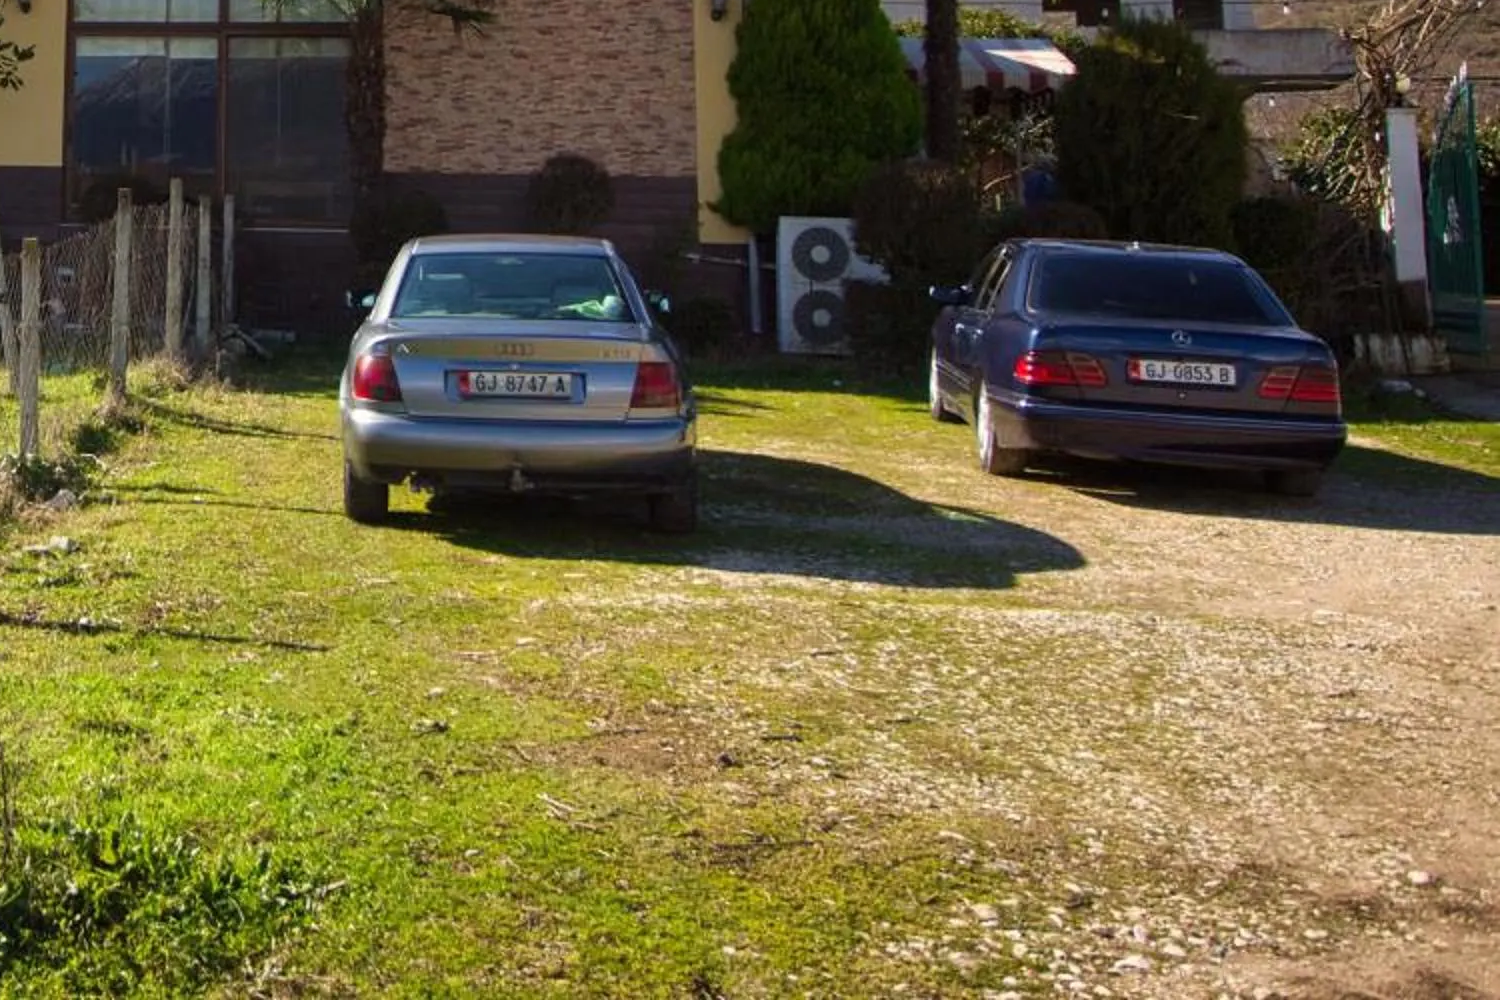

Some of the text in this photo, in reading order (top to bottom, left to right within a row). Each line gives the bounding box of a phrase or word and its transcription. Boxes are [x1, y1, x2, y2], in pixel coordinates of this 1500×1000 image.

[1146, 363, 1165, 378] GJ
[1219, 367, 1230, 382] B
[475, 374, 566, 392] GJ 8747 A
